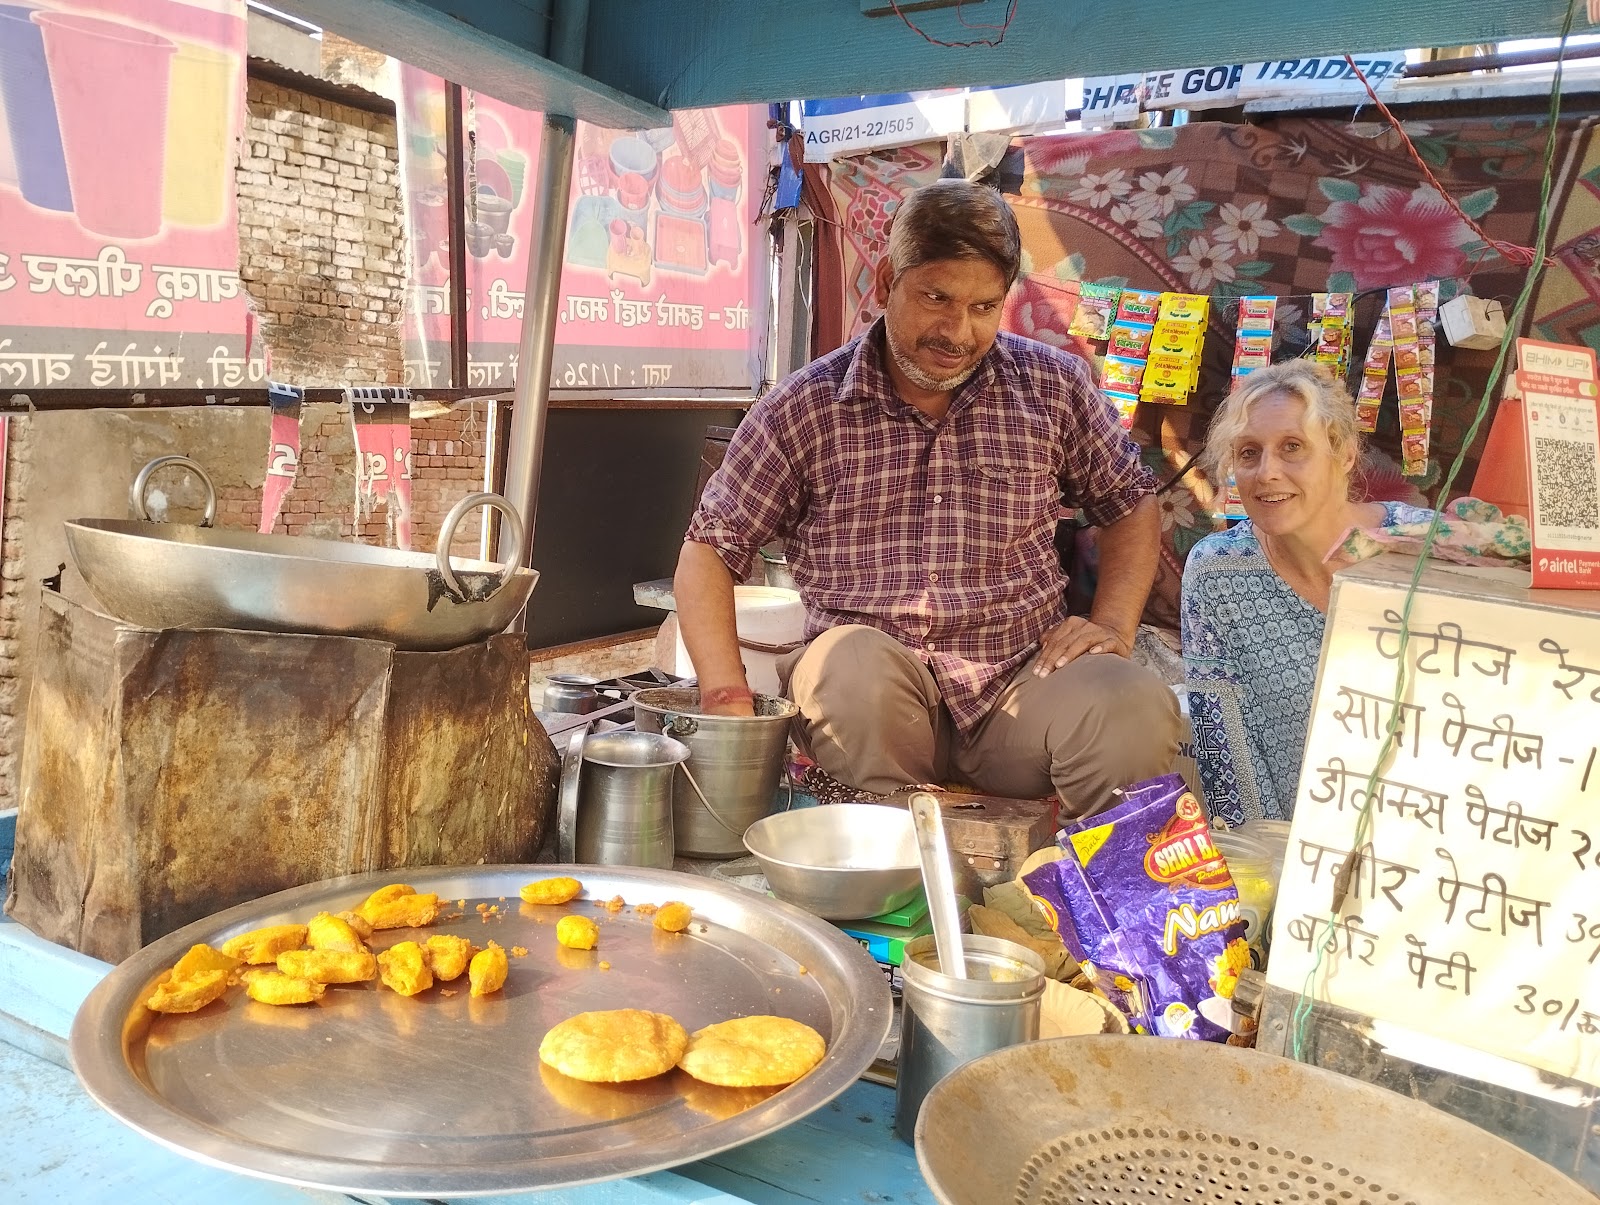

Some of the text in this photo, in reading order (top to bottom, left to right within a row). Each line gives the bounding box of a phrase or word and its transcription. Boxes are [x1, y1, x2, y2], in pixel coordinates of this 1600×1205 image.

[806, 116, 914, 145] AGR/21-22/505
[1549, 556, 1578, 574] airtel
[1539, 637, 1600, 704] रे
[1442, 692, 1544, 770] पेटीज
[1465, 784, 1559, 851] पेटीज
[1153, 837, 1199, 878] SHRI
[1435, 848, 1551, 947] पेटीज
[1405, 933, 1477, 996] पेटी
